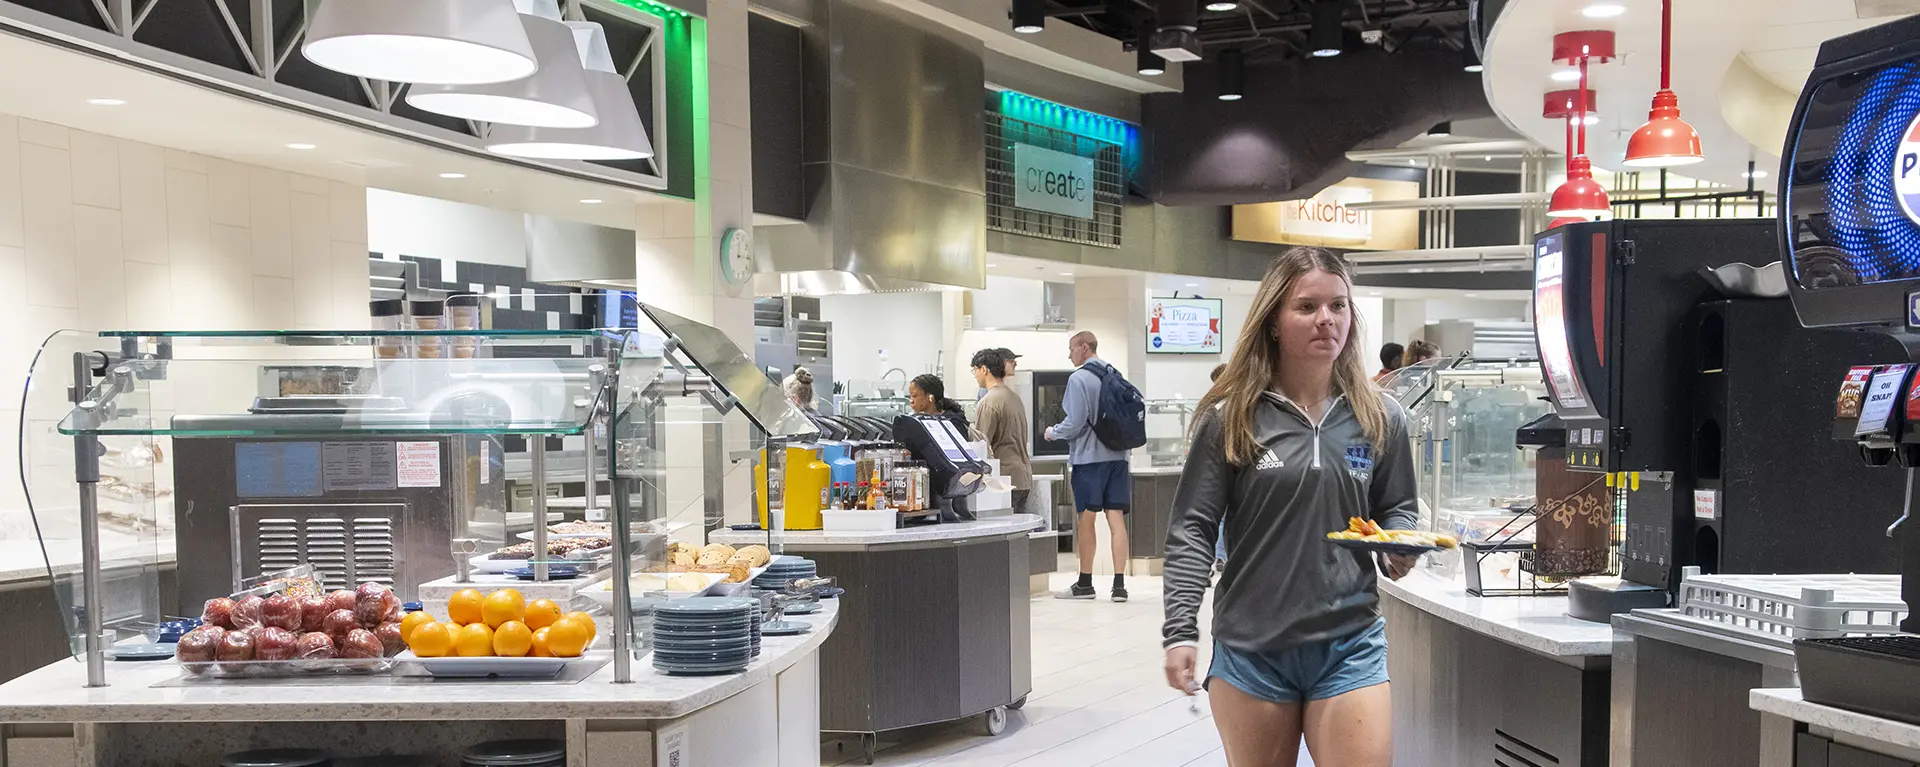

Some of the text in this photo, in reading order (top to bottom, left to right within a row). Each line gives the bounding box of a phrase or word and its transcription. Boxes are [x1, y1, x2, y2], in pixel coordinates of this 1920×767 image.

[1026, 166, 1086, 203] create
[1297, 198, 1369, 226] Kitchen
[1172, 308, 1198, 322] Pizza
[1880, 381, 1892, 391] OH
[1841, 388, 1860, 402] MUG
[1870, 392, 1893, 402] SNAP!
[1255, 460, 1285, 471] adidas
